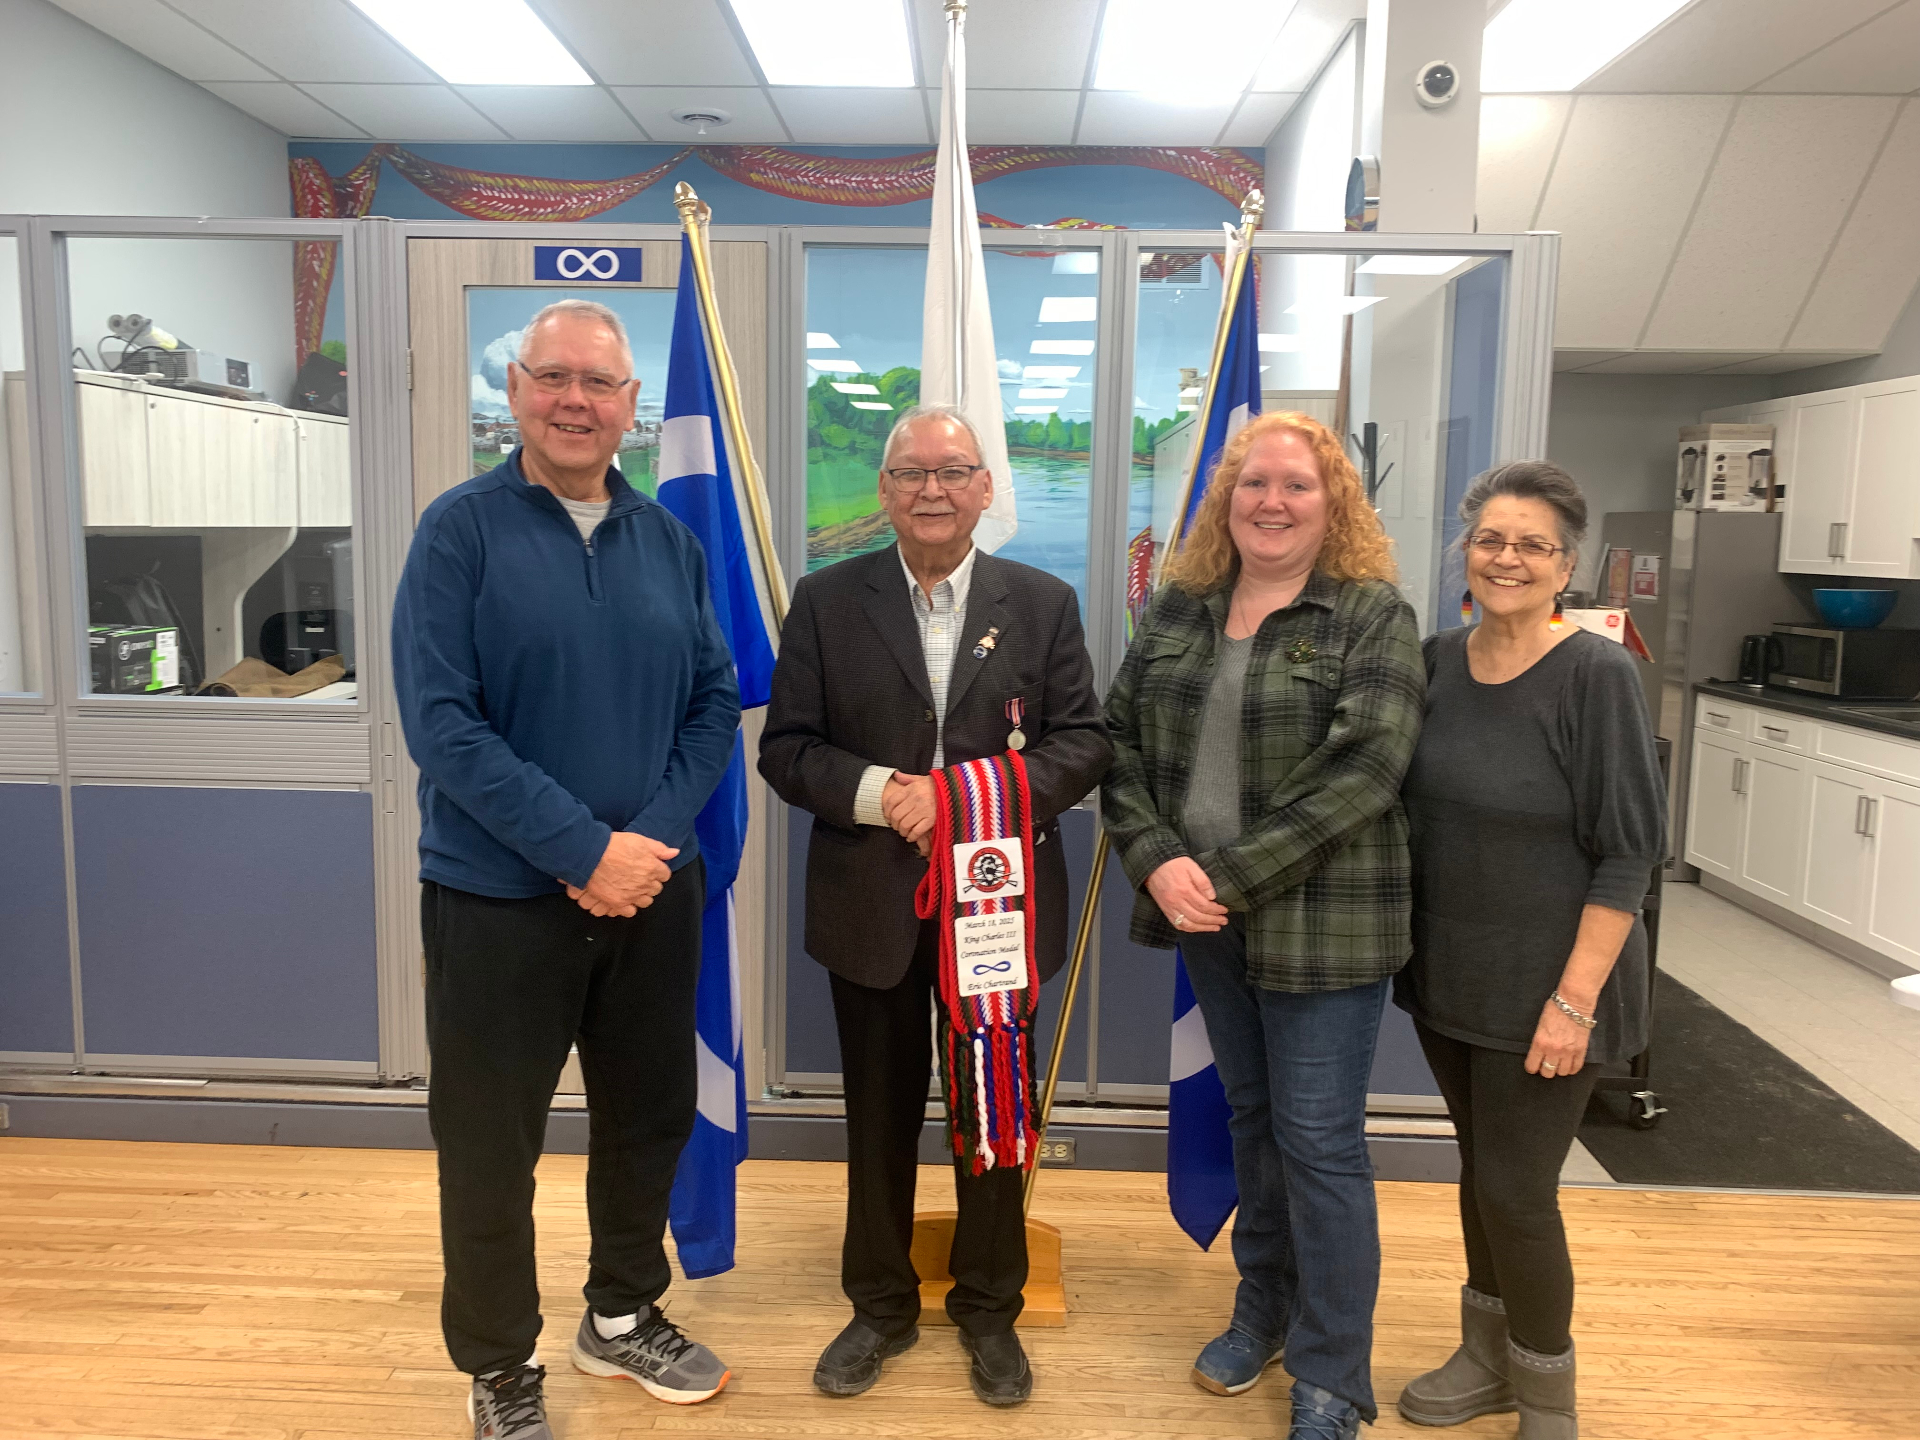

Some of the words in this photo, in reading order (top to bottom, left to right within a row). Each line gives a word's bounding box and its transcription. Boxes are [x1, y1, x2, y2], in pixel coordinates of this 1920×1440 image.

[964, 919, 986, 929] March
[999, 917, 1015, 925] 2025
[964, 936, 980, 944] King
[981, 932, 1005, 942] Charles
[960, 948, 997, 959] Coronation
[998, 943, 1021, 954] Medal
[968, 982, 982, 991] Eric
[983, 977, 1018, 989] Chartrand
